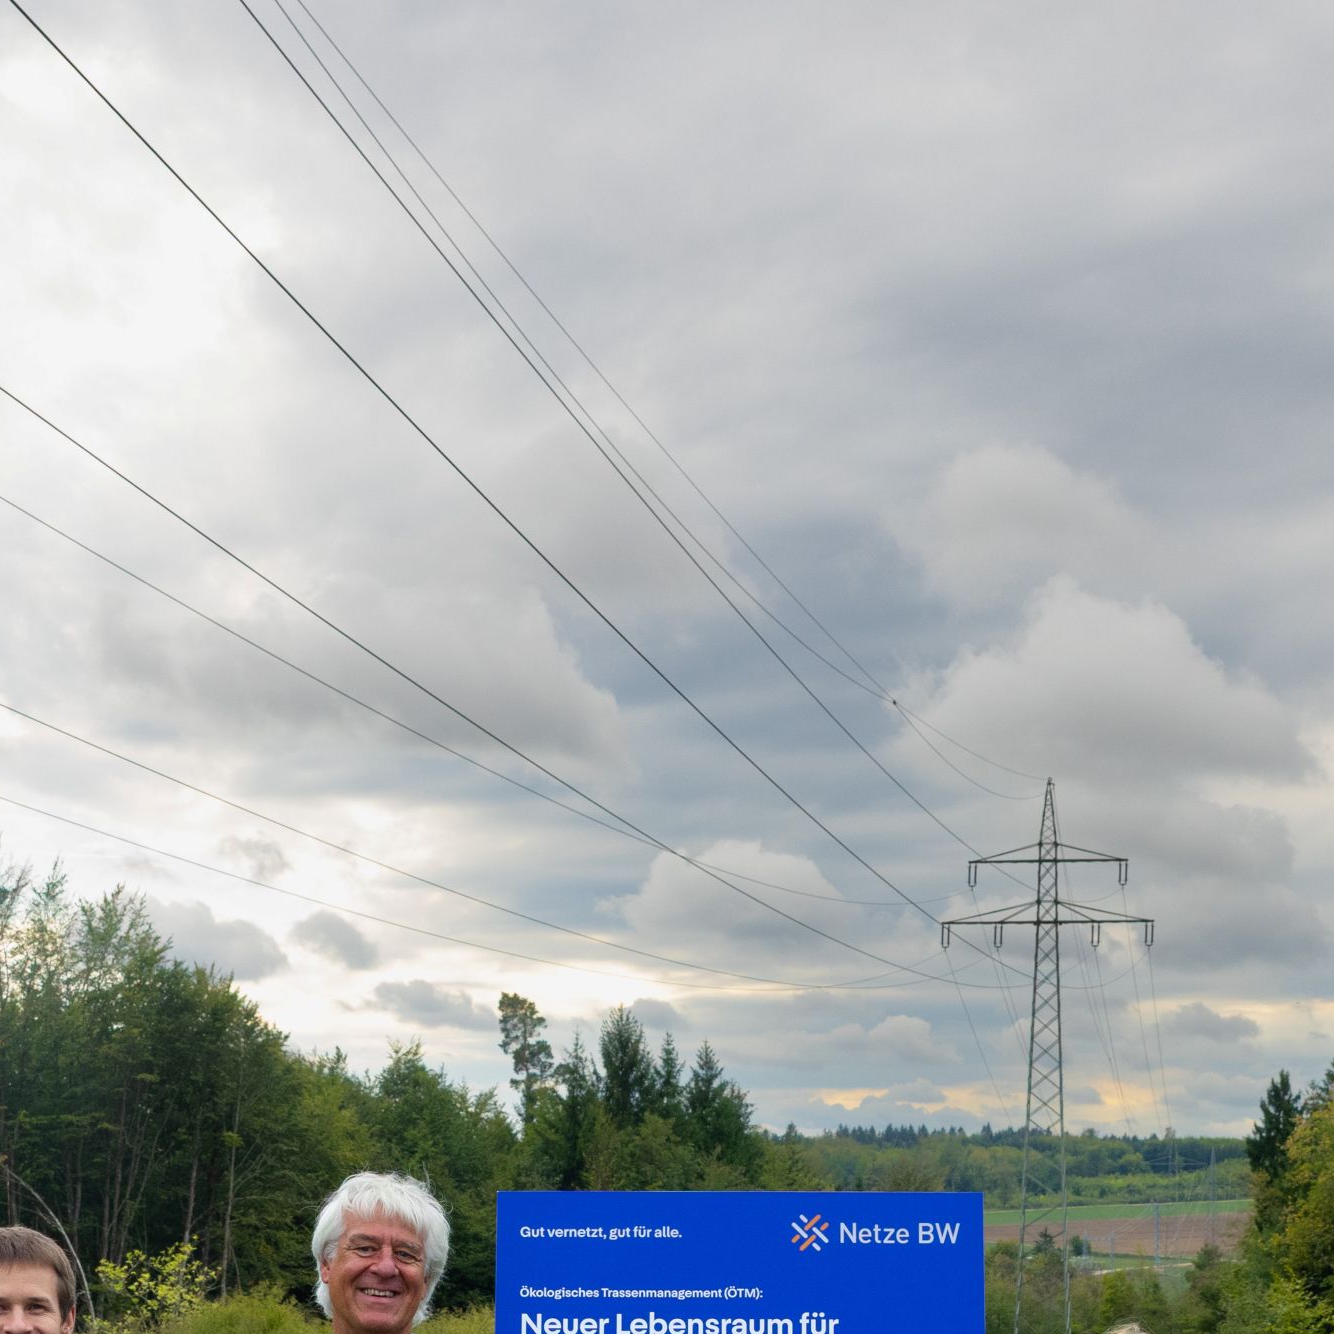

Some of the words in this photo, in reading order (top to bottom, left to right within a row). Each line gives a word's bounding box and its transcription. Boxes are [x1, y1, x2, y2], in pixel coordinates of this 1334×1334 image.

[520, 1226, 545, 1238] Gut
[547, 1227, 607, 1240] vernetzt,
[609, 1227, 631, 1240] gut
[632, 1226, 652, 1238] für
[654, 1226, 682, 1238] alle.
[840, 1222, 910, 1244] Netze
[918, 1222, 960, 1244] BW
[519, 1285, 600, 1300] Ökologisches
[601, 1288, 723, 1300] Trassenmanagement
[724, 1286, 763, 1300] (ÖTM):
